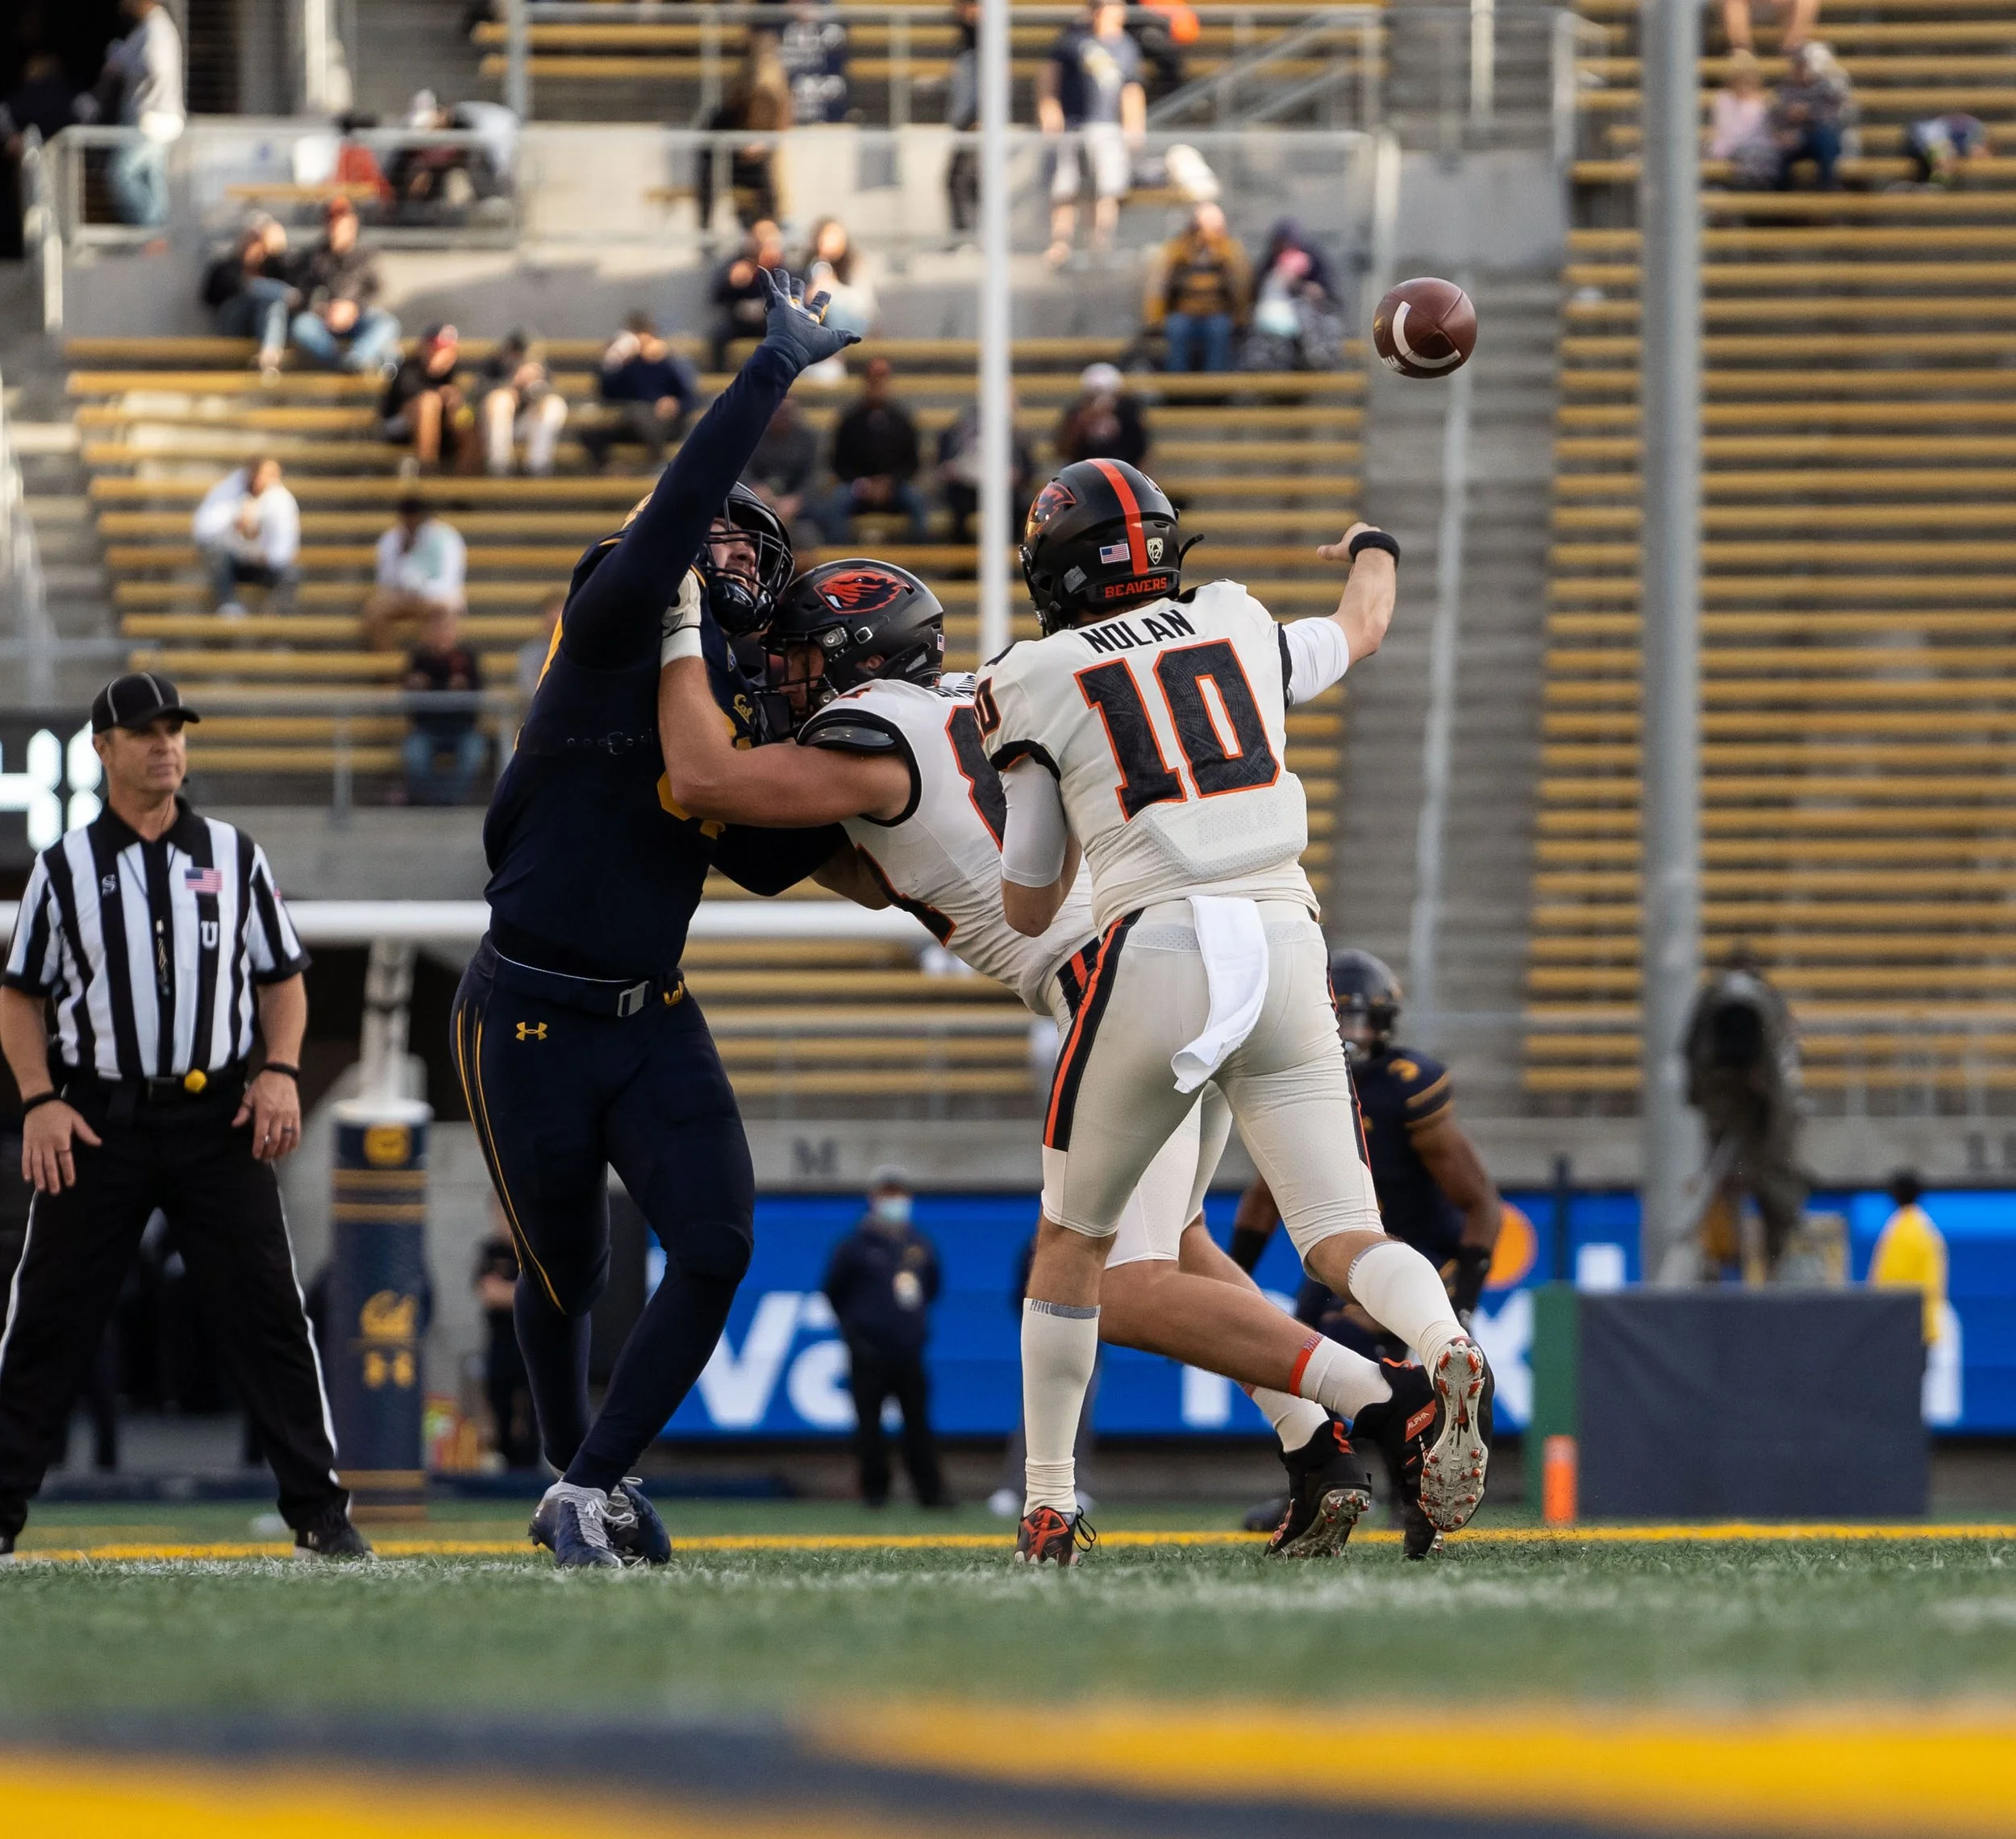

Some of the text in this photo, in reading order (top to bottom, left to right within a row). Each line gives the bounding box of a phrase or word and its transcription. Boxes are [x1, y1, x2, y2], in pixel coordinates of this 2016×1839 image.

[1105, 577, 1167, 598] BEAVERS
[1079, 610, 1195, 654] NOLAN
[1073, 638, 1280, 822] 10
[201, 921, 219, 949] U
[1406, 1412, 1431, 1431] ALPHA
